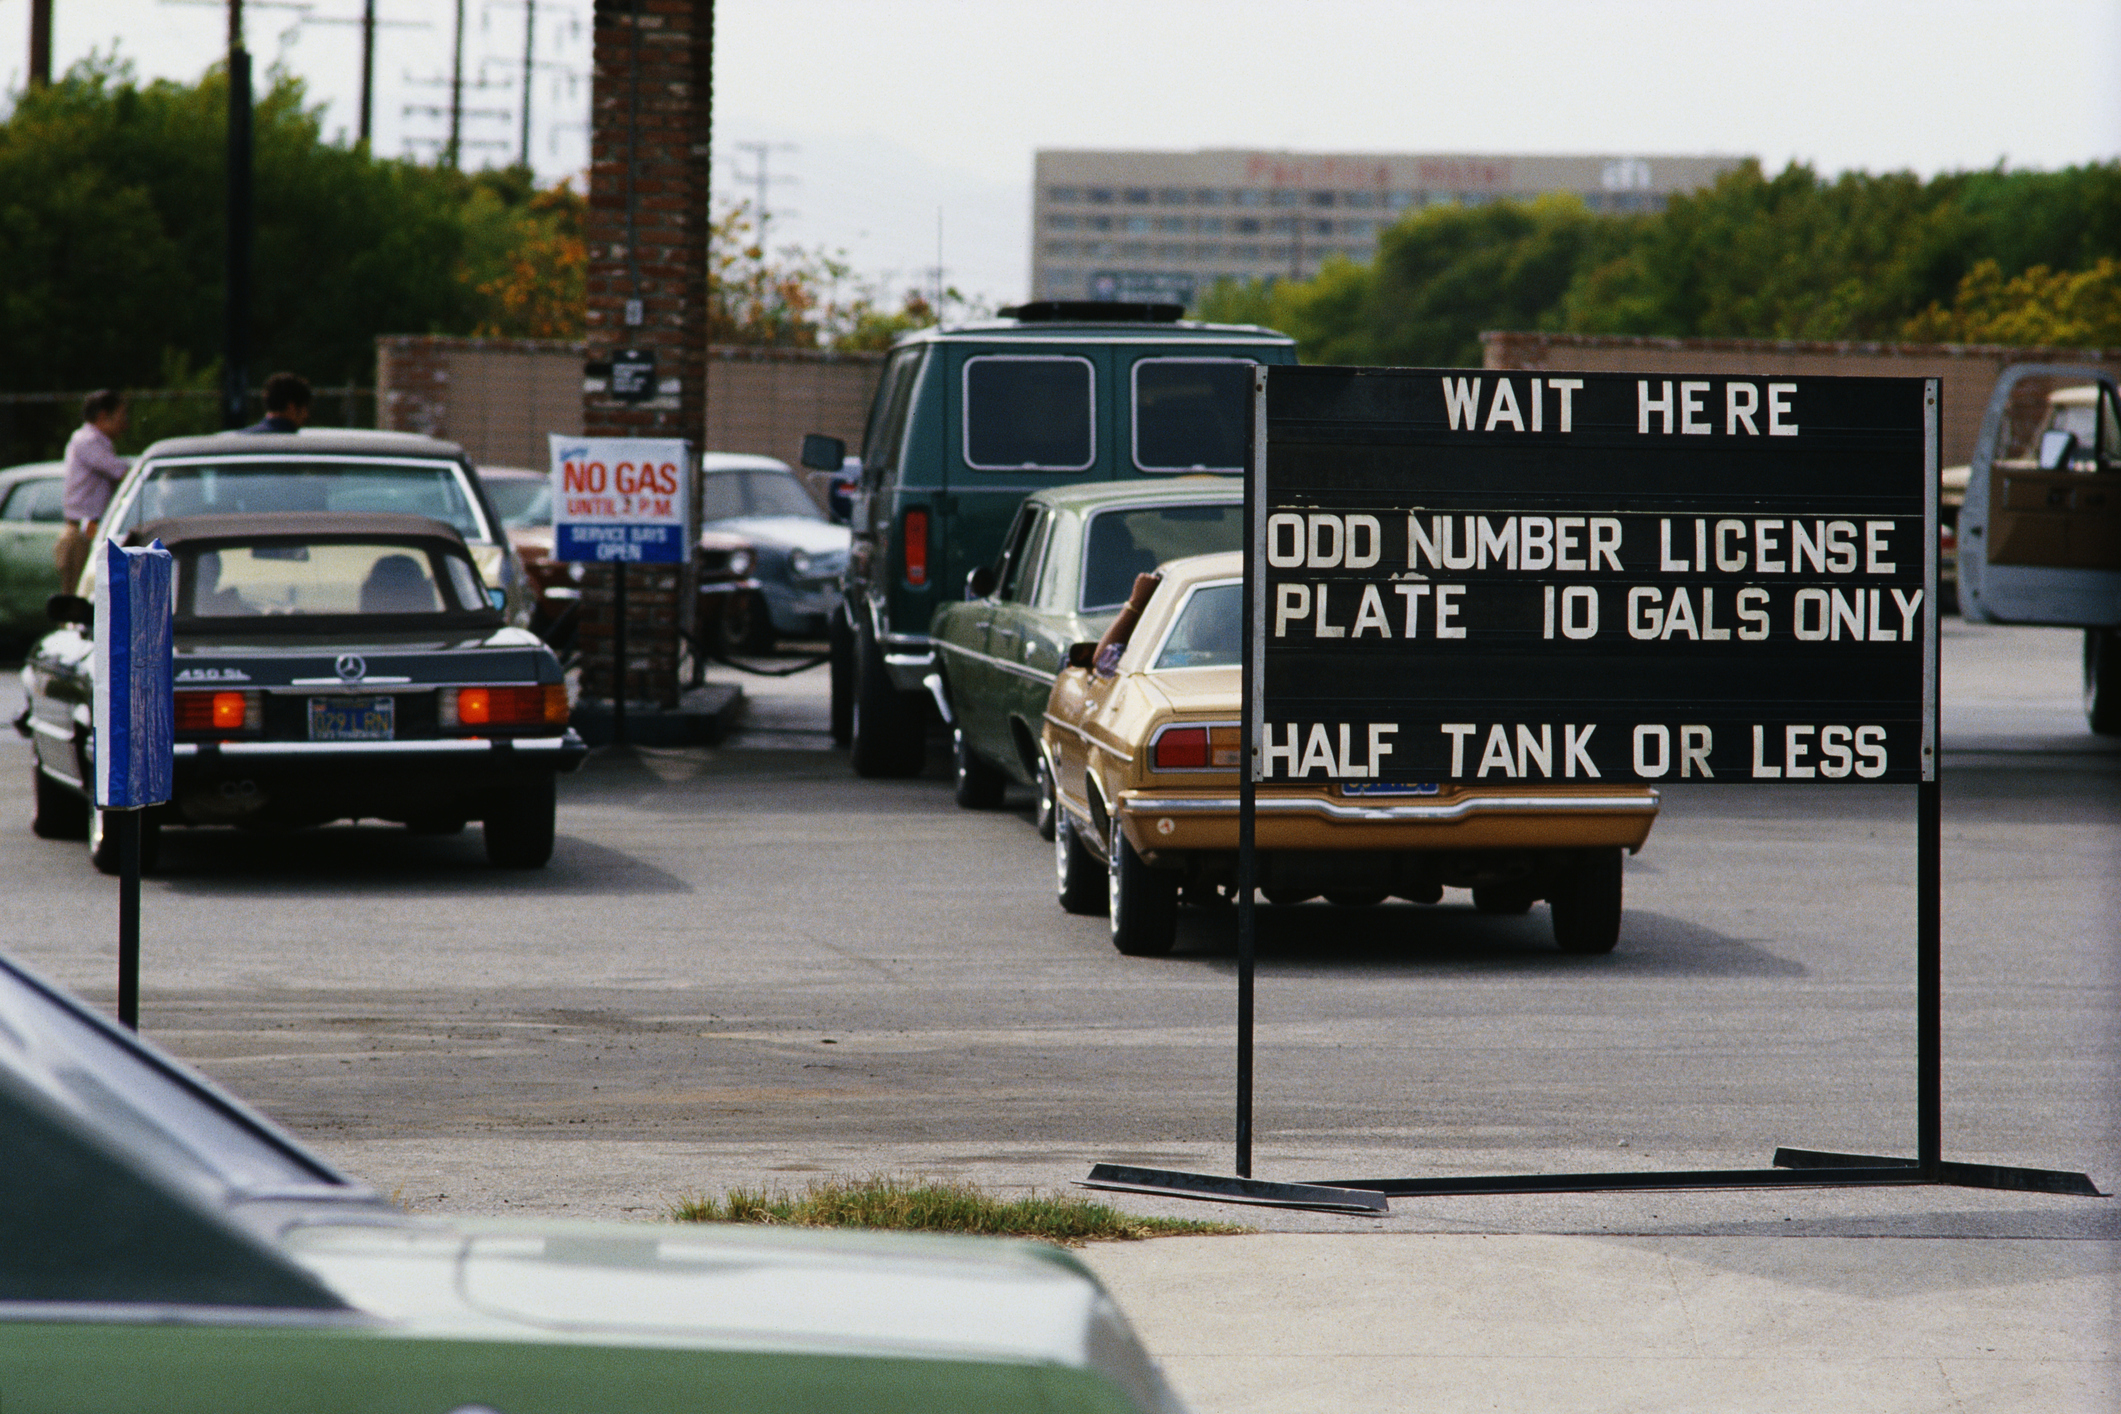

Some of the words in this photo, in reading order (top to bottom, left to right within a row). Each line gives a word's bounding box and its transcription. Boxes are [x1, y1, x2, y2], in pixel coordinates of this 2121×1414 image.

[1443, 377, 1583, 432] WAIT
[1638, 380, 1798, 436] HERE
[564, 460, 607, 493] NO
[615, 461, 677, 495] GAS
[567, 498, 616, 517] UNTIL
[595, 543, 642, 561] OPEN
[1268, 513, 1381, 569] ODD
[1408, 515, 1623, 571] NUMBER
[1661, 519, 1896, 574] LICENSE
[1275, 584, 1466, 639] PLATE
[1544, 586, 1598, 640] 10
[1628, 587, 1769, 640] GALS
[1794, 588, 1923, 641] ONLY
[1263, 723, 1399, 777] HALF
[1441, 724, 1601, 778] TANK
[1633, 724, 1713, 777] OR
[1753, 725, 1887, 778] LESS
